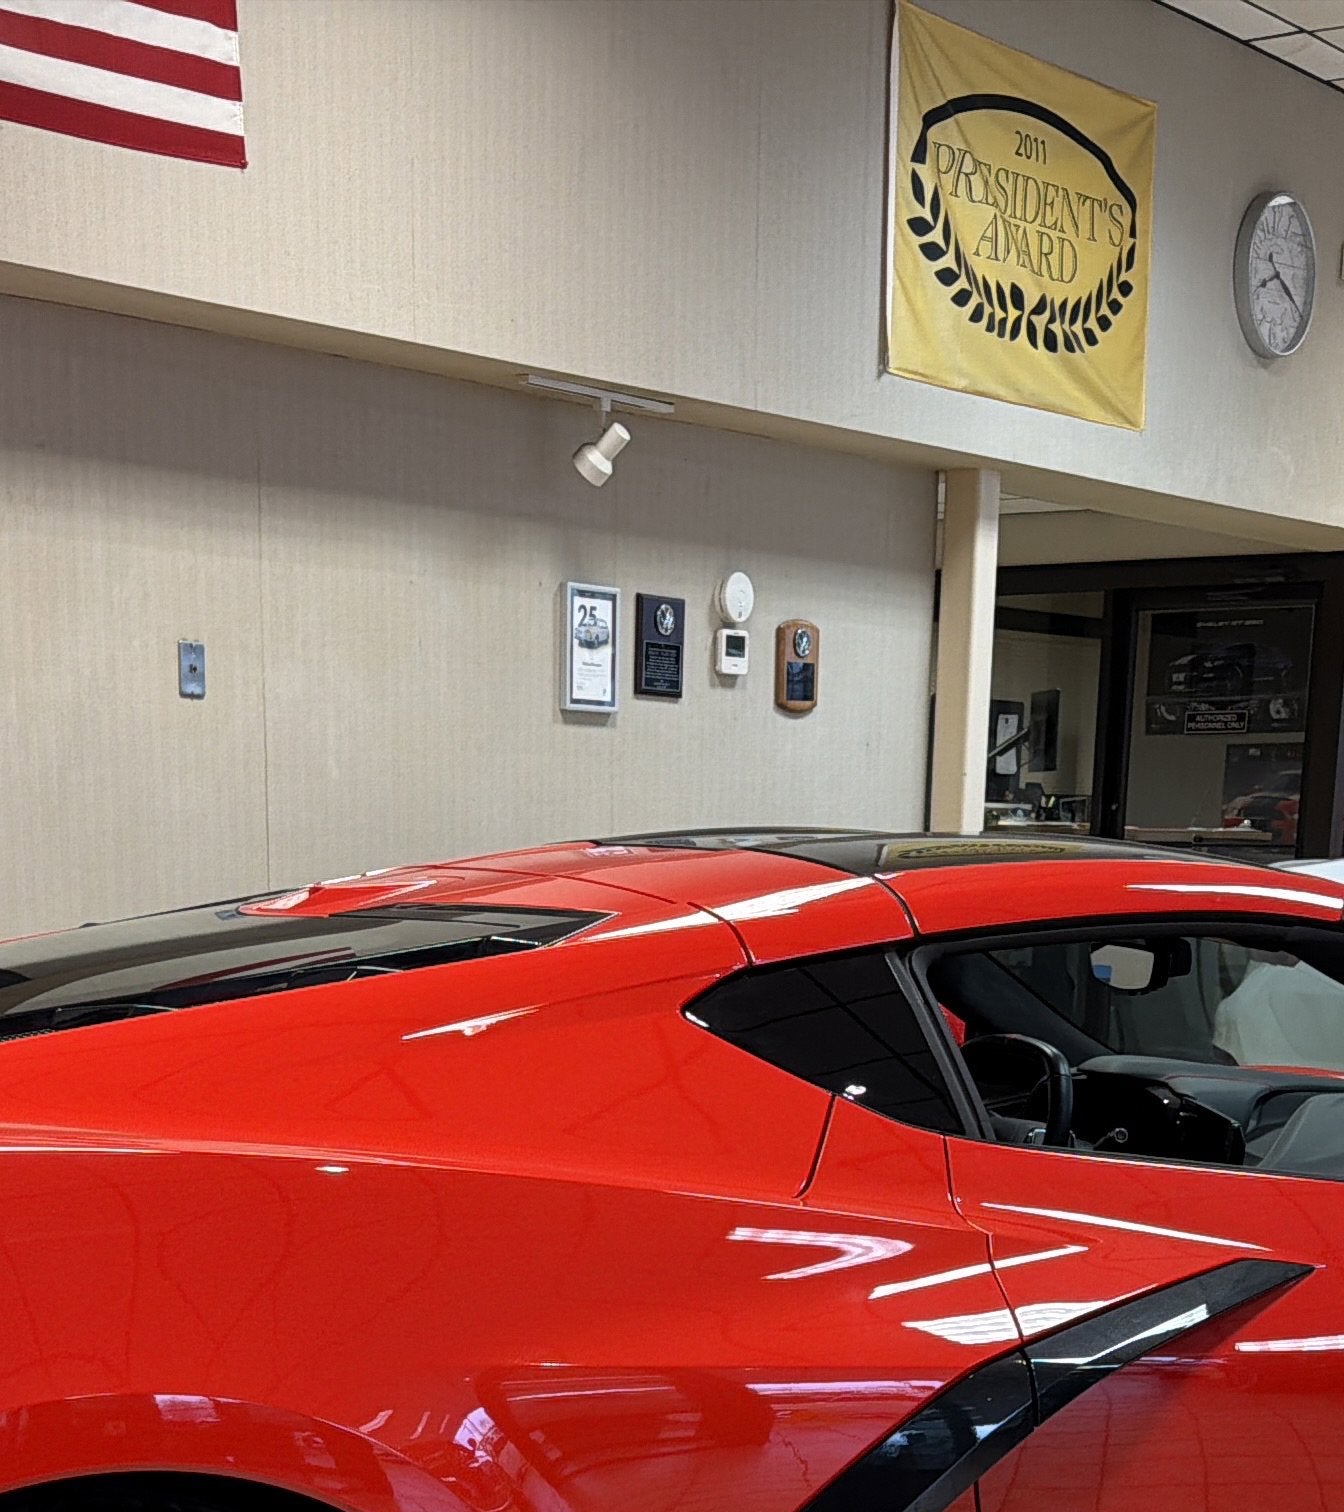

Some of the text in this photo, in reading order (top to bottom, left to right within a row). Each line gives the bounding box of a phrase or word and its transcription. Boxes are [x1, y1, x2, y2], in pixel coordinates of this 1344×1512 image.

[1015, 130, 1047, 165] 2011
[932, 141, 1125, 248] PRESIDENT'S
[972, 212, 1079, 284] AWARD
[578, 604, 597, 628] 25
[1187, 721, 1245, 730] PERSONNEL ONLY
[1196, 714, 1238, 722] AUTHORIZED
